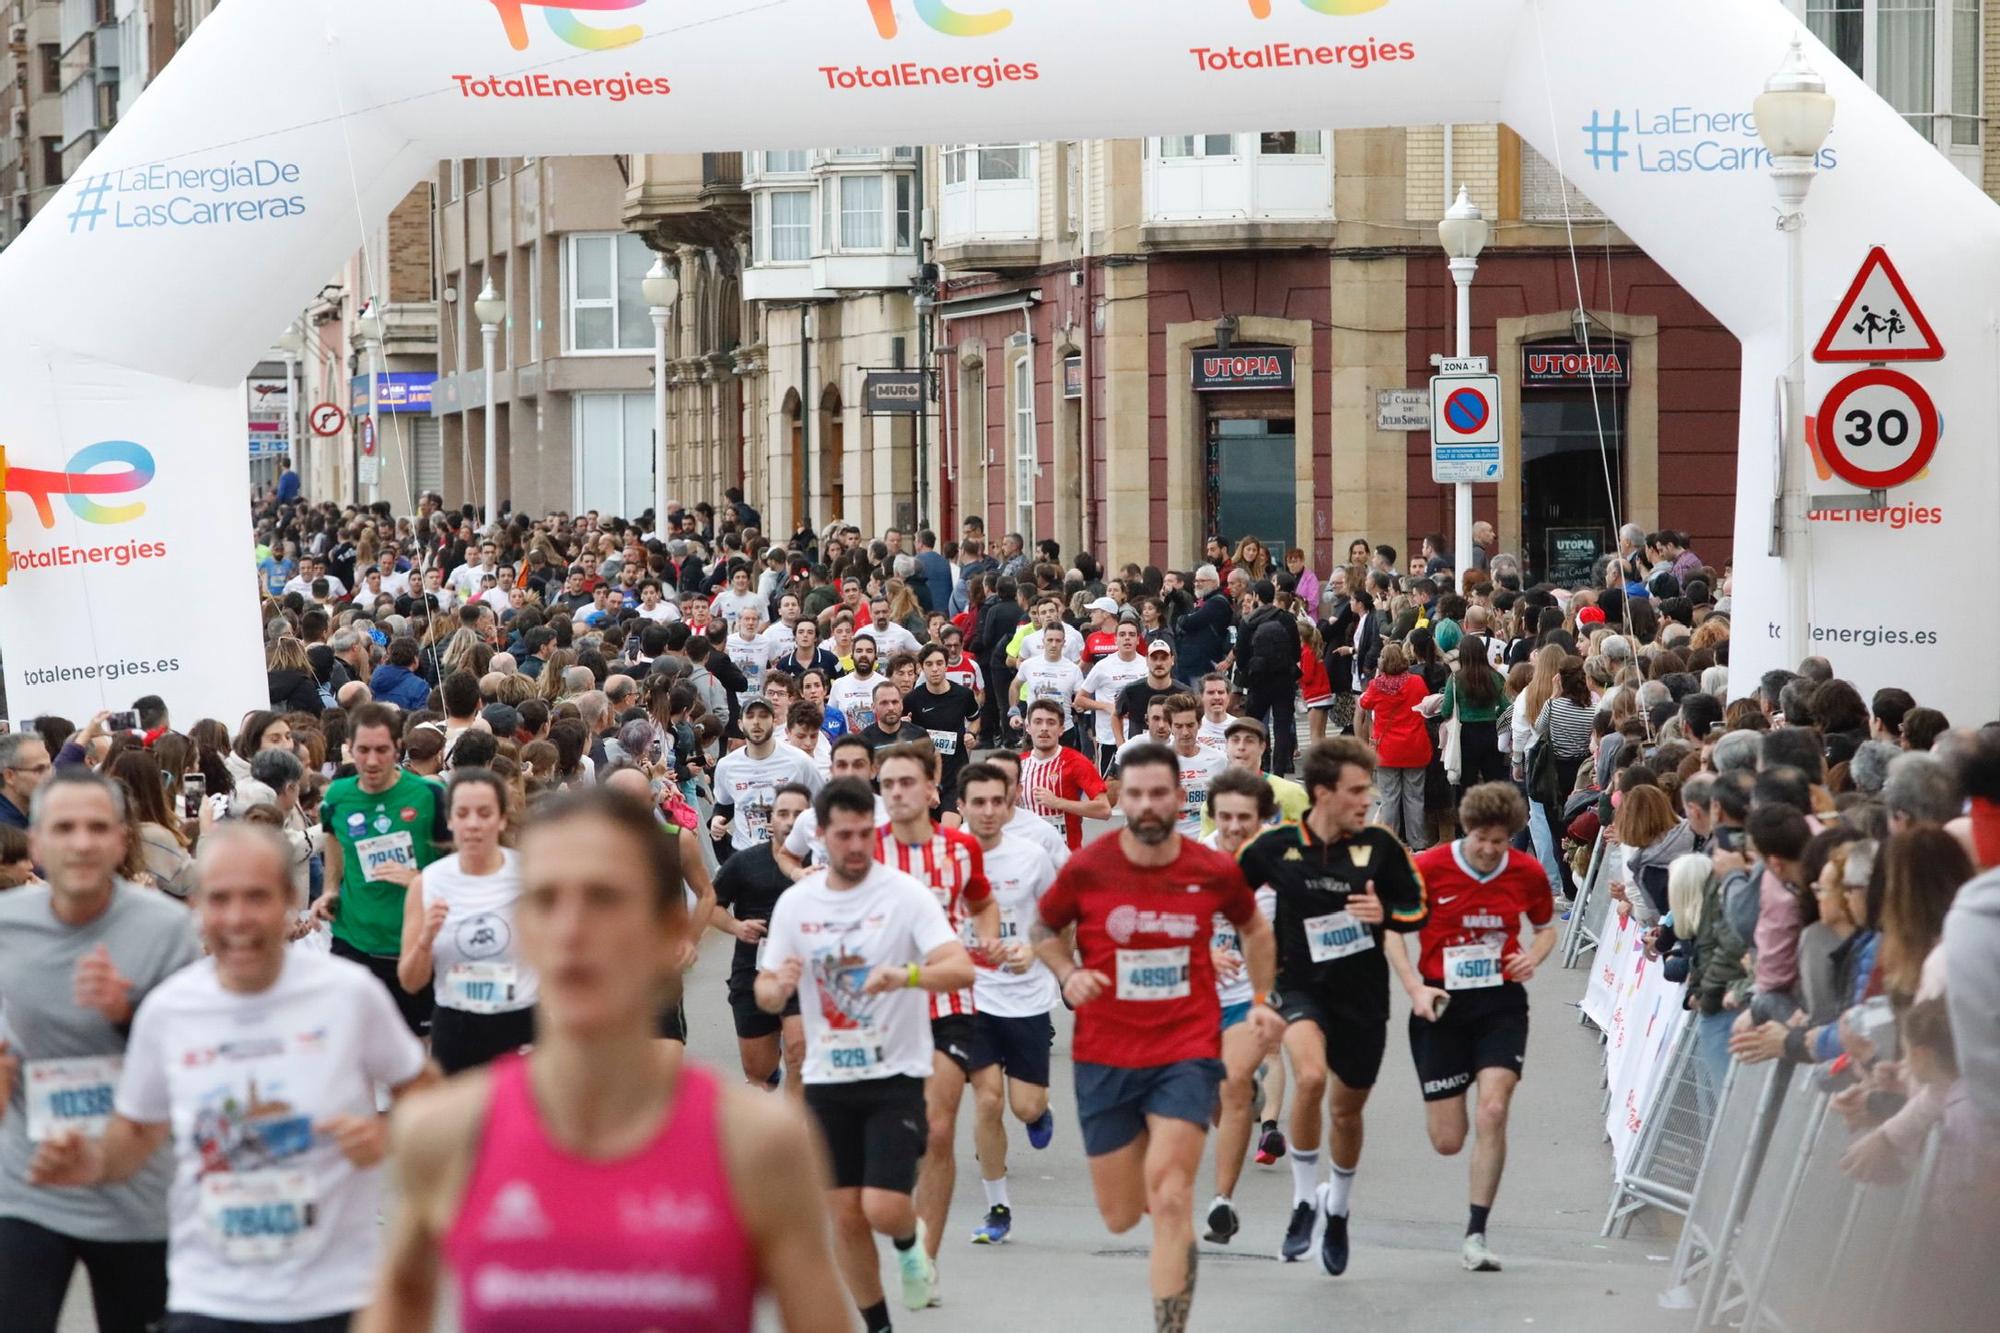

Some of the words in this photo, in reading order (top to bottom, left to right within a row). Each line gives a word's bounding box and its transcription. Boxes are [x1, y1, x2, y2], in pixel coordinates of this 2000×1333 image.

[1189, 37, 1415, 71] TotalEnergies
[452, 72, 671, 102] TotalEnergies
[818, 58, 1039, 88] TotalEnergies
[115, 195, 306, 228] LasCarreras
[1203, 356, 1282, 377] UTOPIA
[1444, 362, 1469, 371] ZONA
[1479, 362, 1483, 370] 1
[1528, 353, 1623, 374] UTOPIA
[1844, 409, 1909, 447] 30
[11, 539, 167, 571] TotalEnergies
[1556, 539, 1595, 549] UTOPIA
[24, 658, 180, 686] totalenergies.es
[1456, 958, 1491, 979] 4507
[831, 1047, 867, 1069] 829
